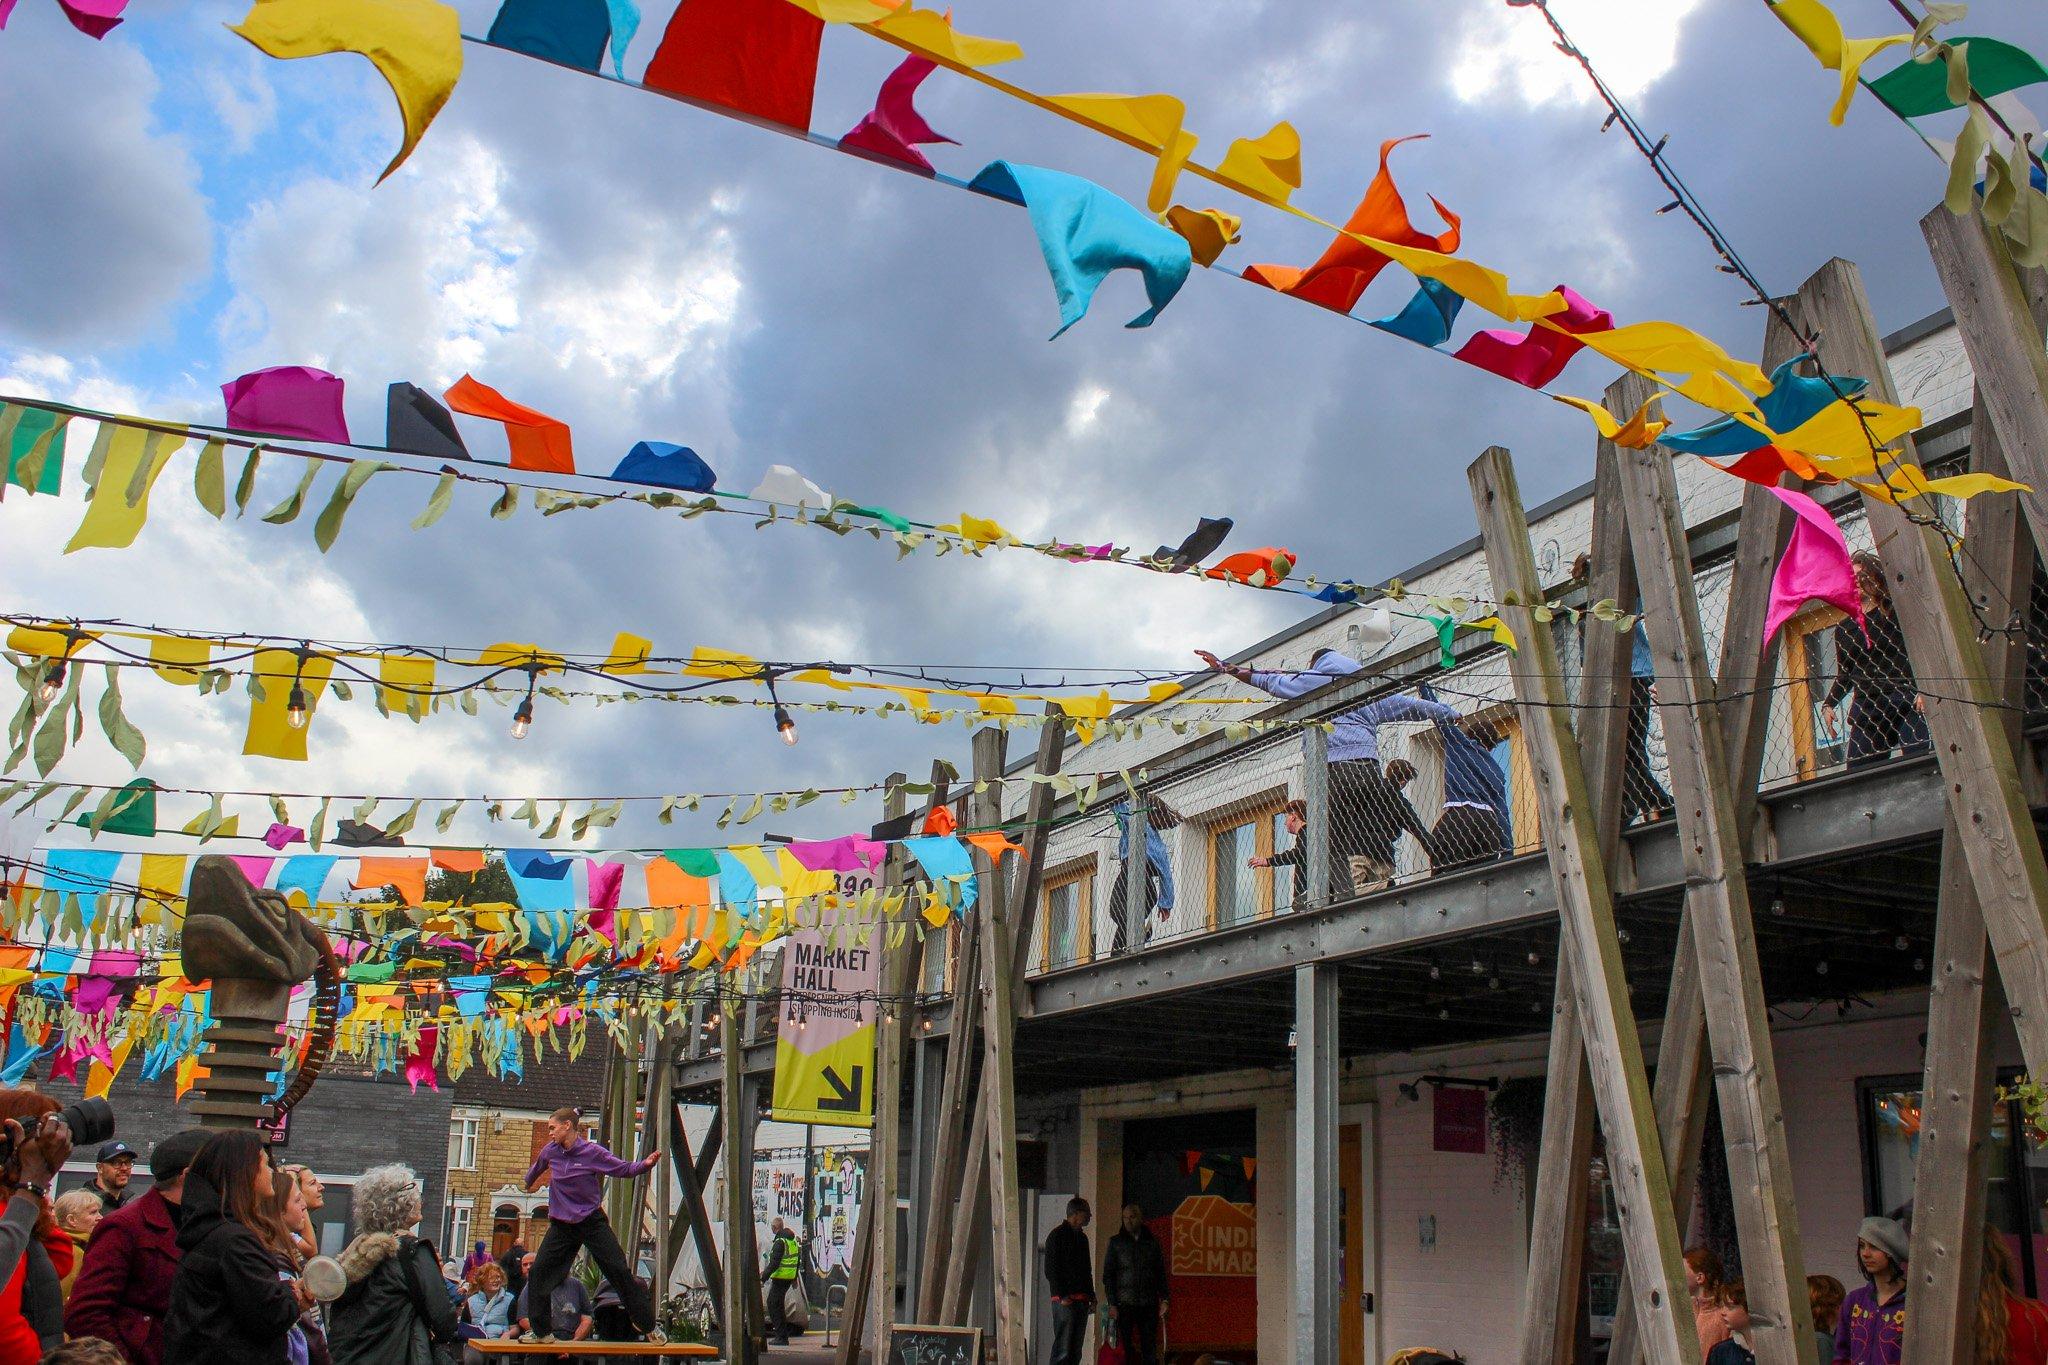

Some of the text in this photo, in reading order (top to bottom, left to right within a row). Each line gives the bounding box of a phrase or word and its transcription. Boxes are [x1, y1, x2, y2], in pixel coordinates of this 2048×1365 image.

[795, 942, 870, 971] MARKET
[793, 966, 837, 992] HALL
[792, 1003, 857, 1020] SHOPPING INSID
[777, 1190, 803, 1218] CARS
